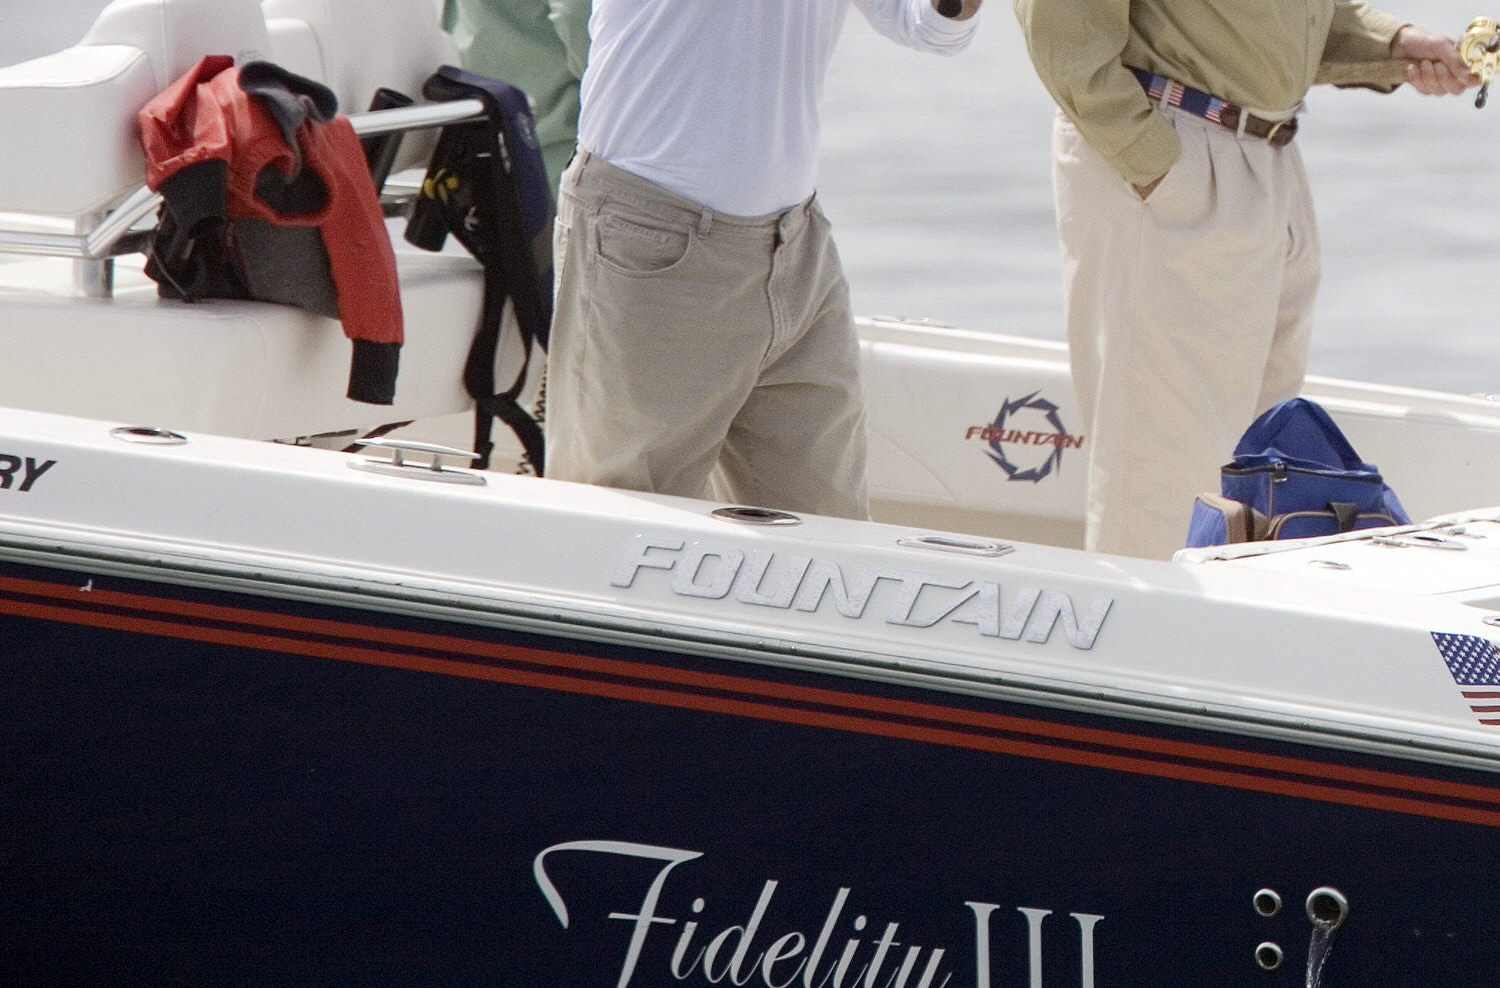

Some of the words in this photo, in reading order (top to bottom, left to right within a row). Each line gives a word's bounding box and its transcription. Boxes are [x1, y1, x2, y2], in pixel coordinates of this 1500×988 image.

[965, 425, 1085, 449] FOUNTAIN
[610, 535, 1115, 651] FOUNTAIN
[533, 840, 952, 988] Fidelity
[964, 901, 1105, 988] III
